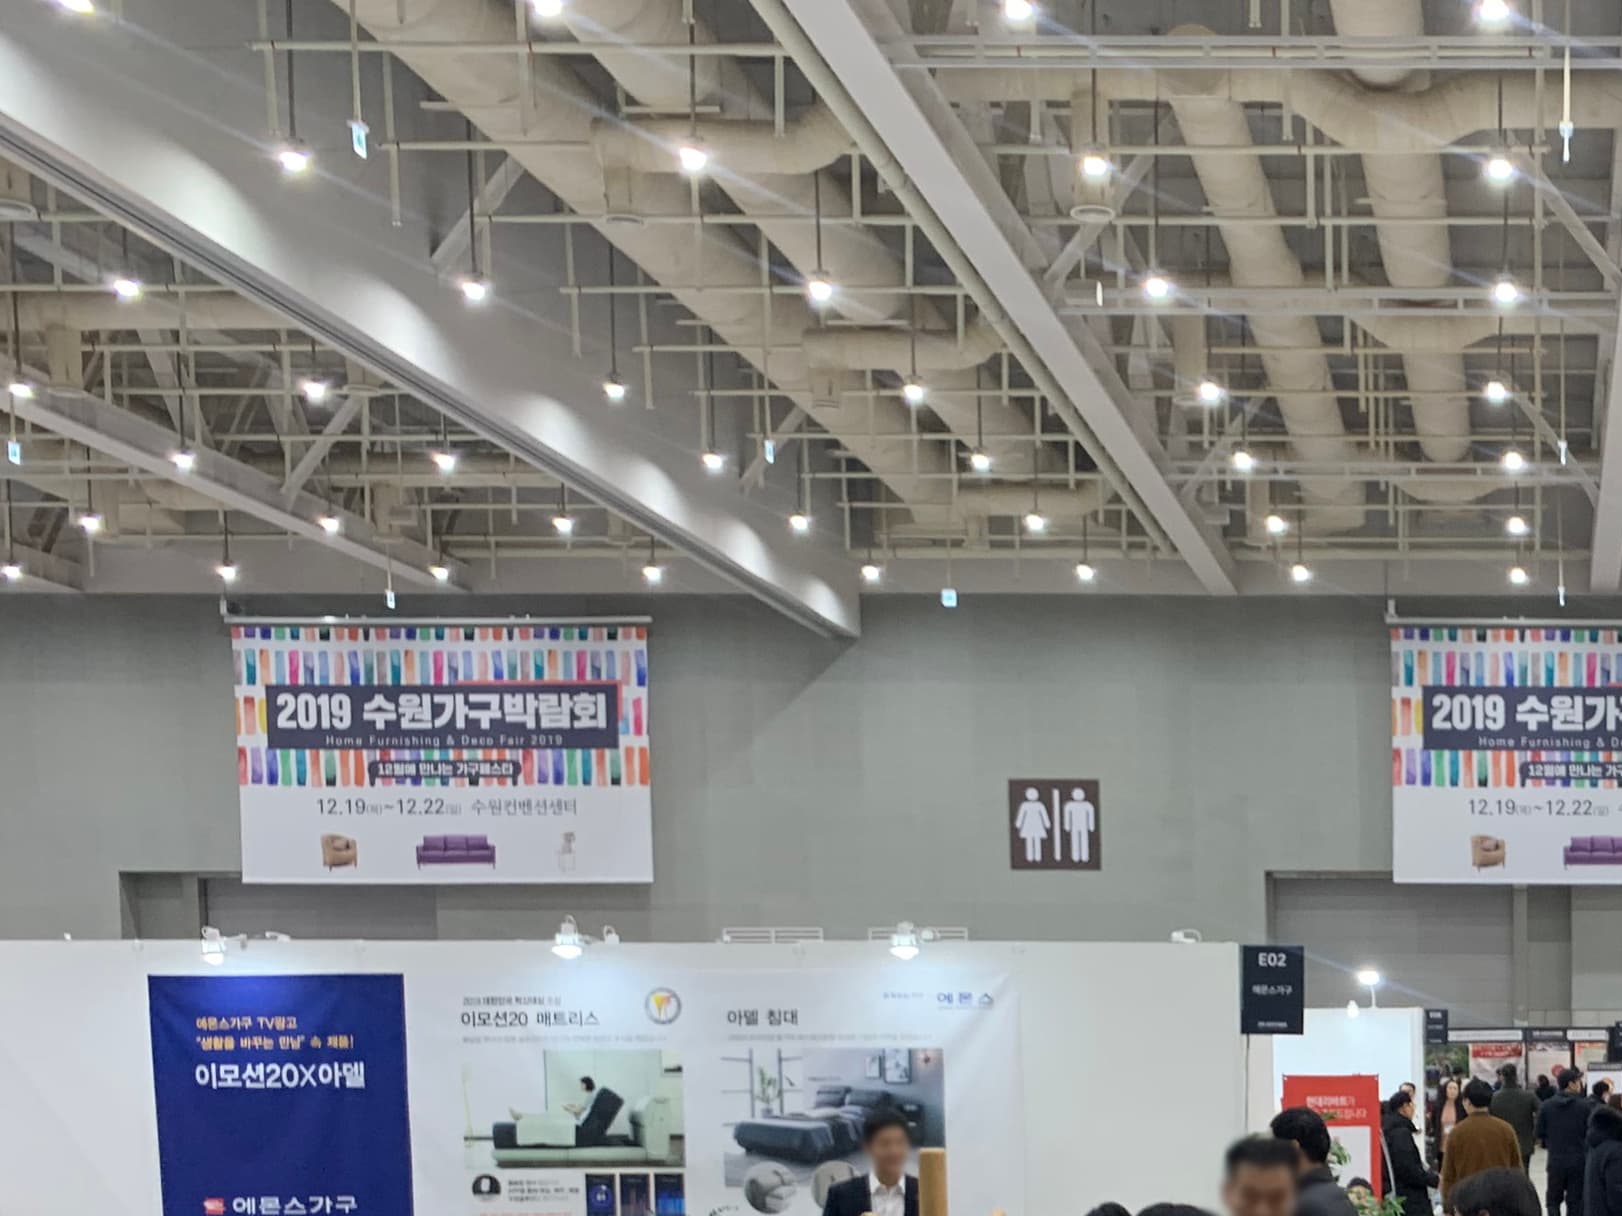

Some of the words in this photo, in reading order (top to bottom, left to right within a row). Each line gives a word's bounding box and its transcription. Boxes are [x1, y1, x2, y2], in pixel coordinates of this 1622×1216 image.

[276, 692, 352, 731] 2019
[362, 691, 607, 731] 수원가구박람회
[1431, 693, 1506, 731] 2019
[326, 735, 363, 746] Home
[369, 735, 440, 748] Furnishing
[461, 735, 494, 746] Deco
[501, 734, 525, 746] Fair
[531, 734, 563, 746] 2019
[1478, 736, 1515, 748] Home
[1520, 736, 1590, 749] Furnishing
[471, 798, 578, 817] 수원컨벤션센터
[1258, 952, 1287, 967] E02
[460, 1010, 528, 1029] 이모션20
[536, 1010, 601, 1028] 매트리스
[194, 1060, 366, 1090] 이모션20X아델
[232, 1194, 359, 1216] 에몬스가구
